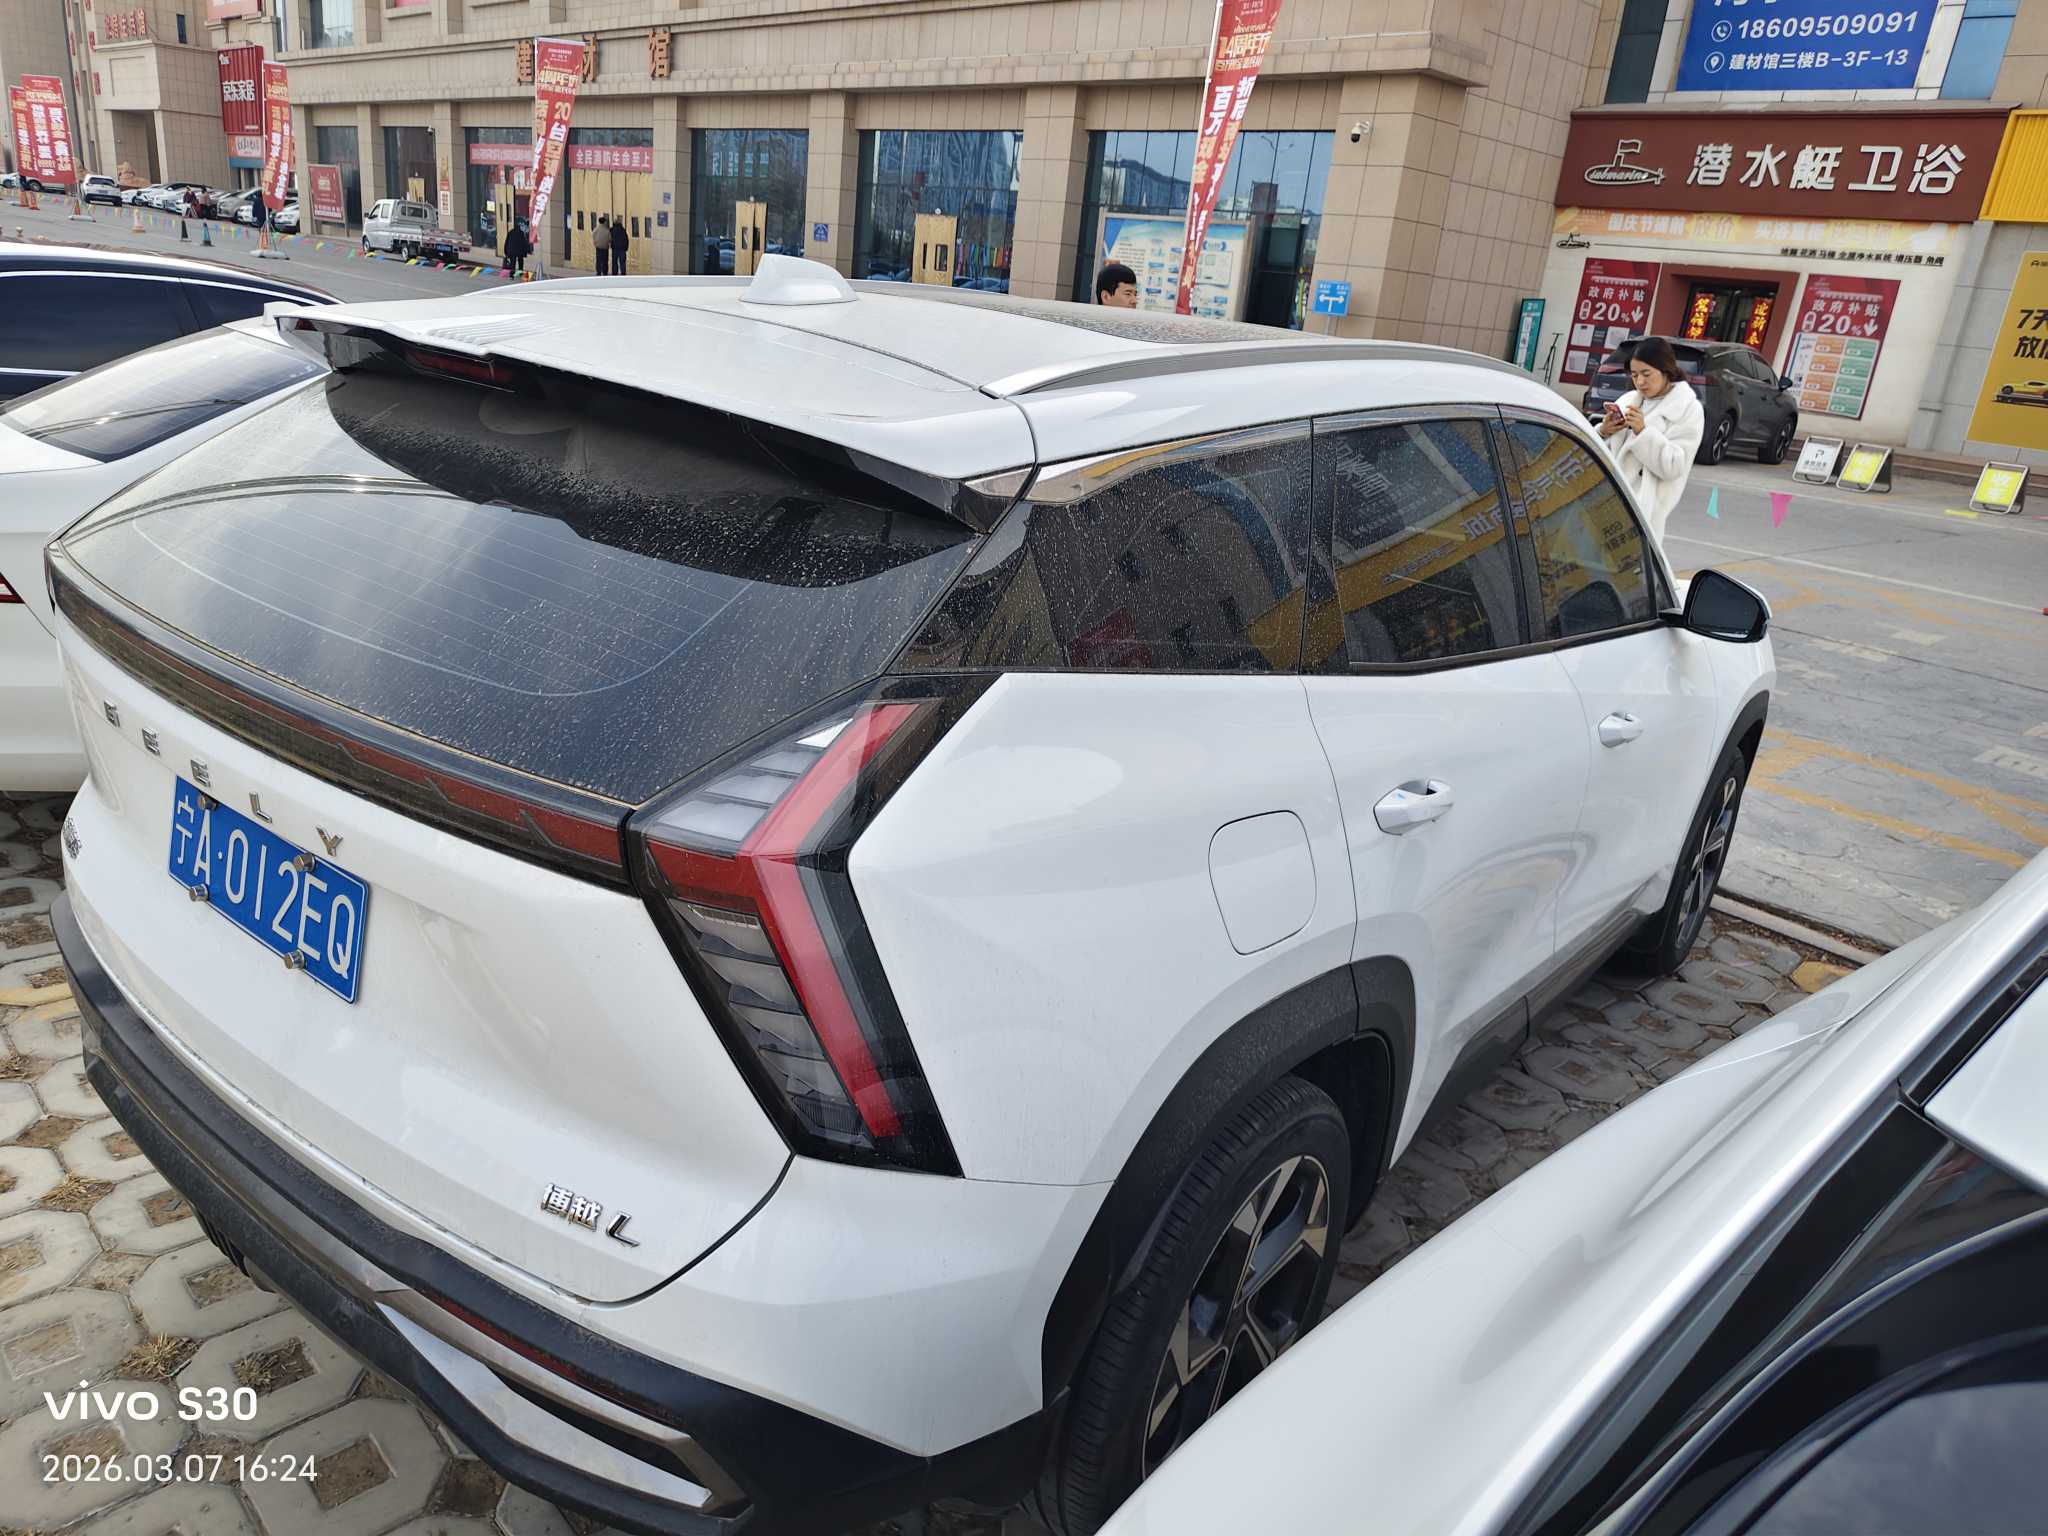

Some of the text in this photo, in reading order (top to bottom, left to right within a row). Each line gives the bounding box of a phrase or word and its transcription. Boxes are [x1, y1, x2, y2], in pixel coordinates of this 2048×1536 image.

[1737, 11, 1919, 40] 18609509091
[1729, 49, 1909, 71] 建材馆三楼B-3F-13
[575, 149, 651, 168] 全民消防生命至上
[1686, 143, 1968, 195] 潜水艇卫浴
[1588, 286, 1646, 303] 政府补贴
[1593, 302, 1631, 323] 20%
[1812, 299, 1880, 318] 政府补贴
[1818, 313, 1862, 336] 20%
[104, 699, 344, 857] GEELY
[541, 1183, 640, 1248] 博越 L
